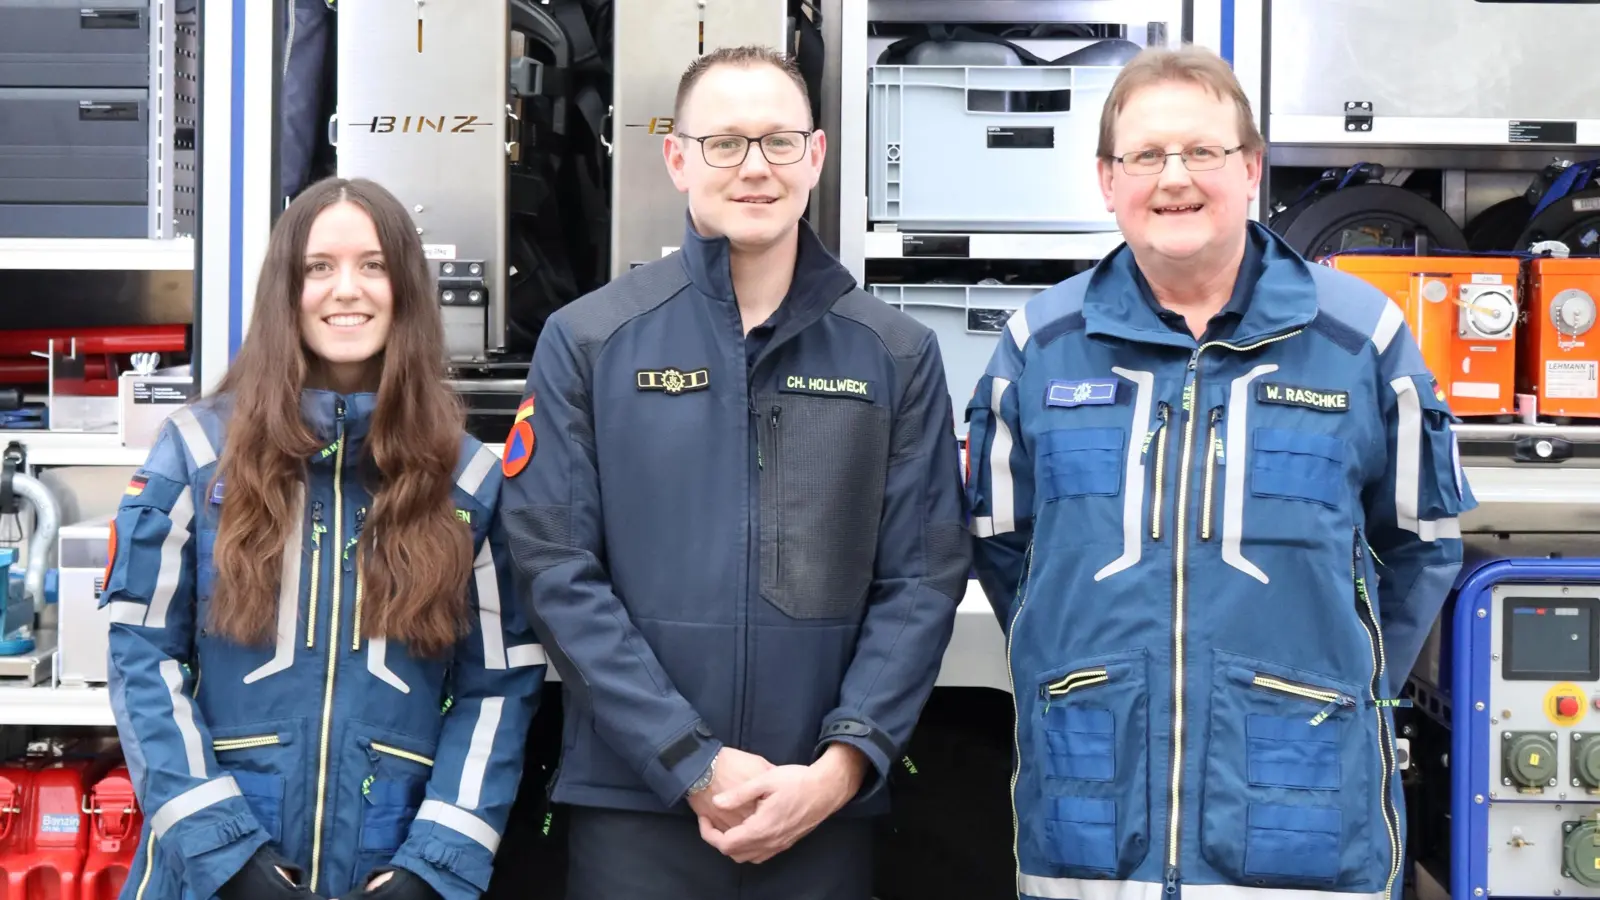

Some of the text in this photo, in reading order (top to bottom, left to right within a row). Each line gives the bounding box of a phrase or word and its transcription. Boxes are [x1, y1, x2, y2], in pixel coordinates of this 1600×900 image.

[370, 116, 478, 133] BINZ
[786, 376, 867, 395] CH. HOLLWECK
[1182, 386, 1192, 411] THW
[1266, 385, 1346, 408] W. RASCHKE
[1375, 699, 1401, 708] THW
